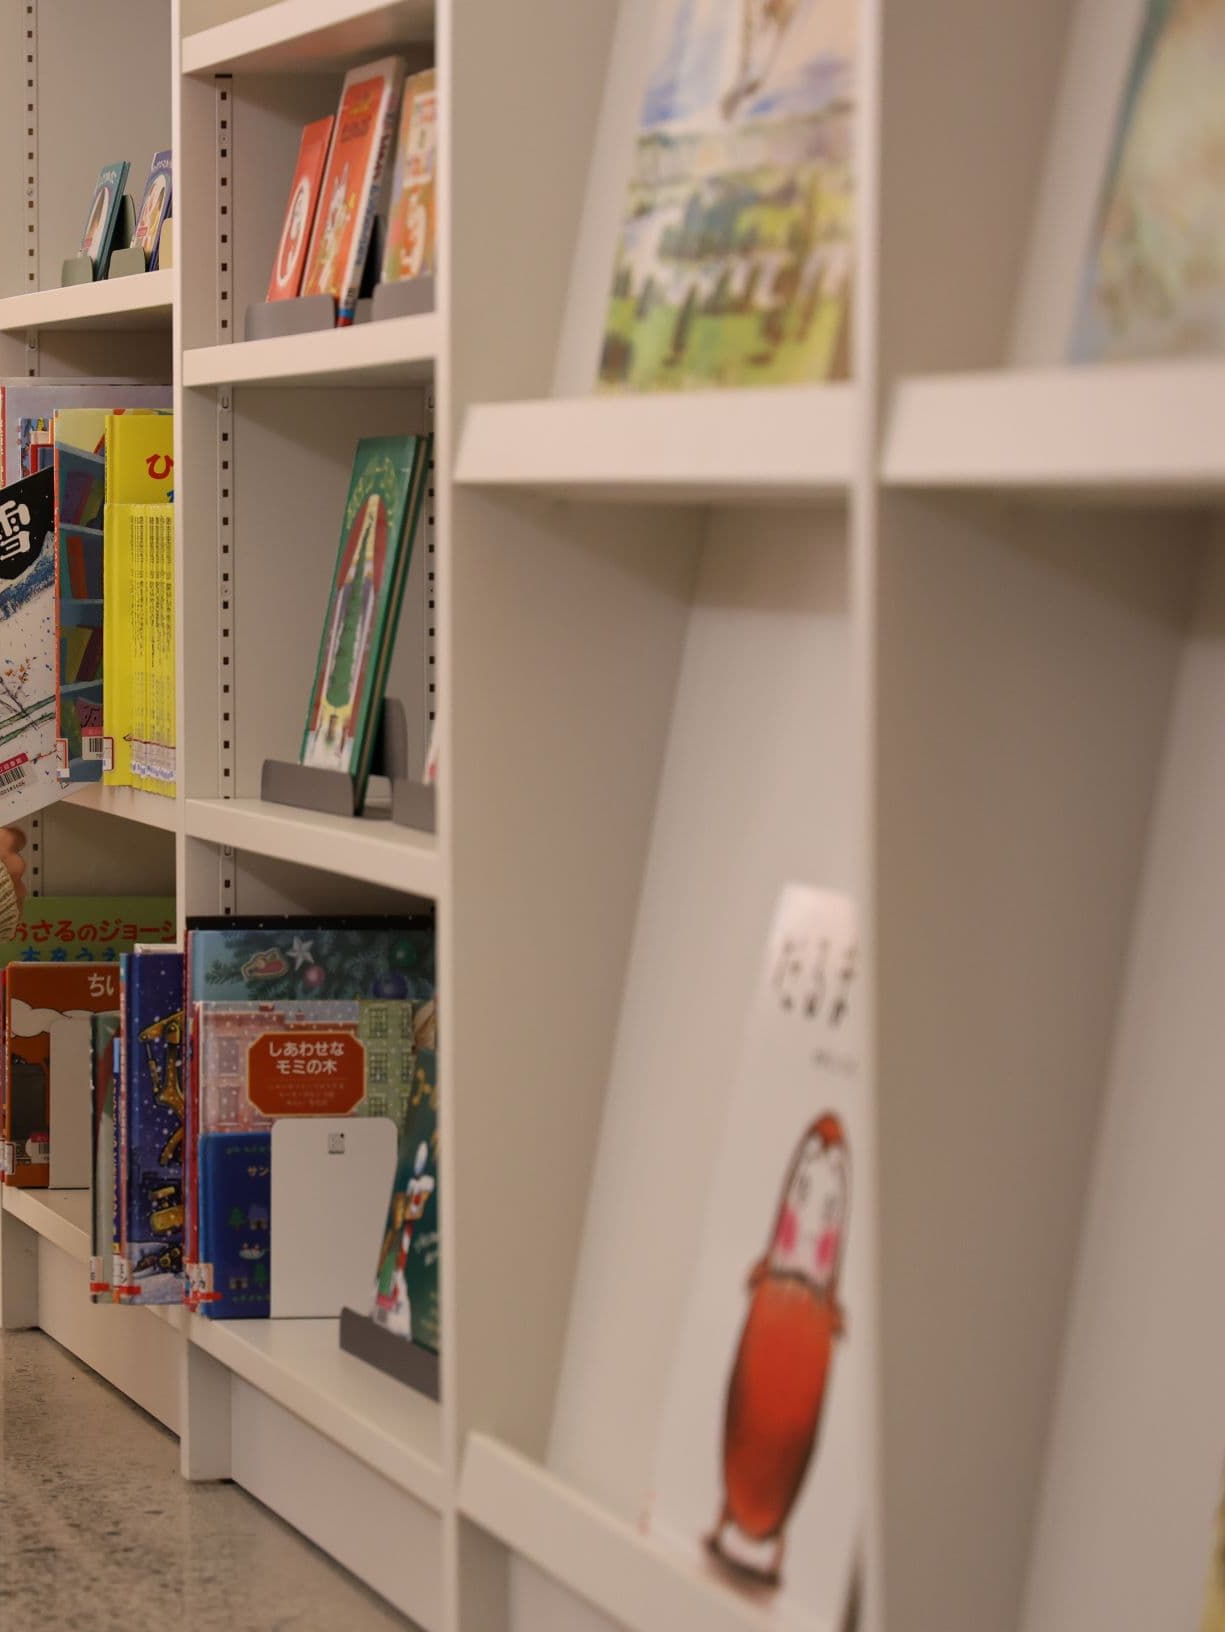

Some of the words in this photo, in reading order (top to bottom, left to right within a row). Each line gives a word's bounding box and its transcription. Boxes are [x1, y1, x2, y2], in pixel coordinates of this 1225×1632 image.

[269, 1041, 344, 1057] しあわせな
[276, 1059, 337, 1075] モミの木
